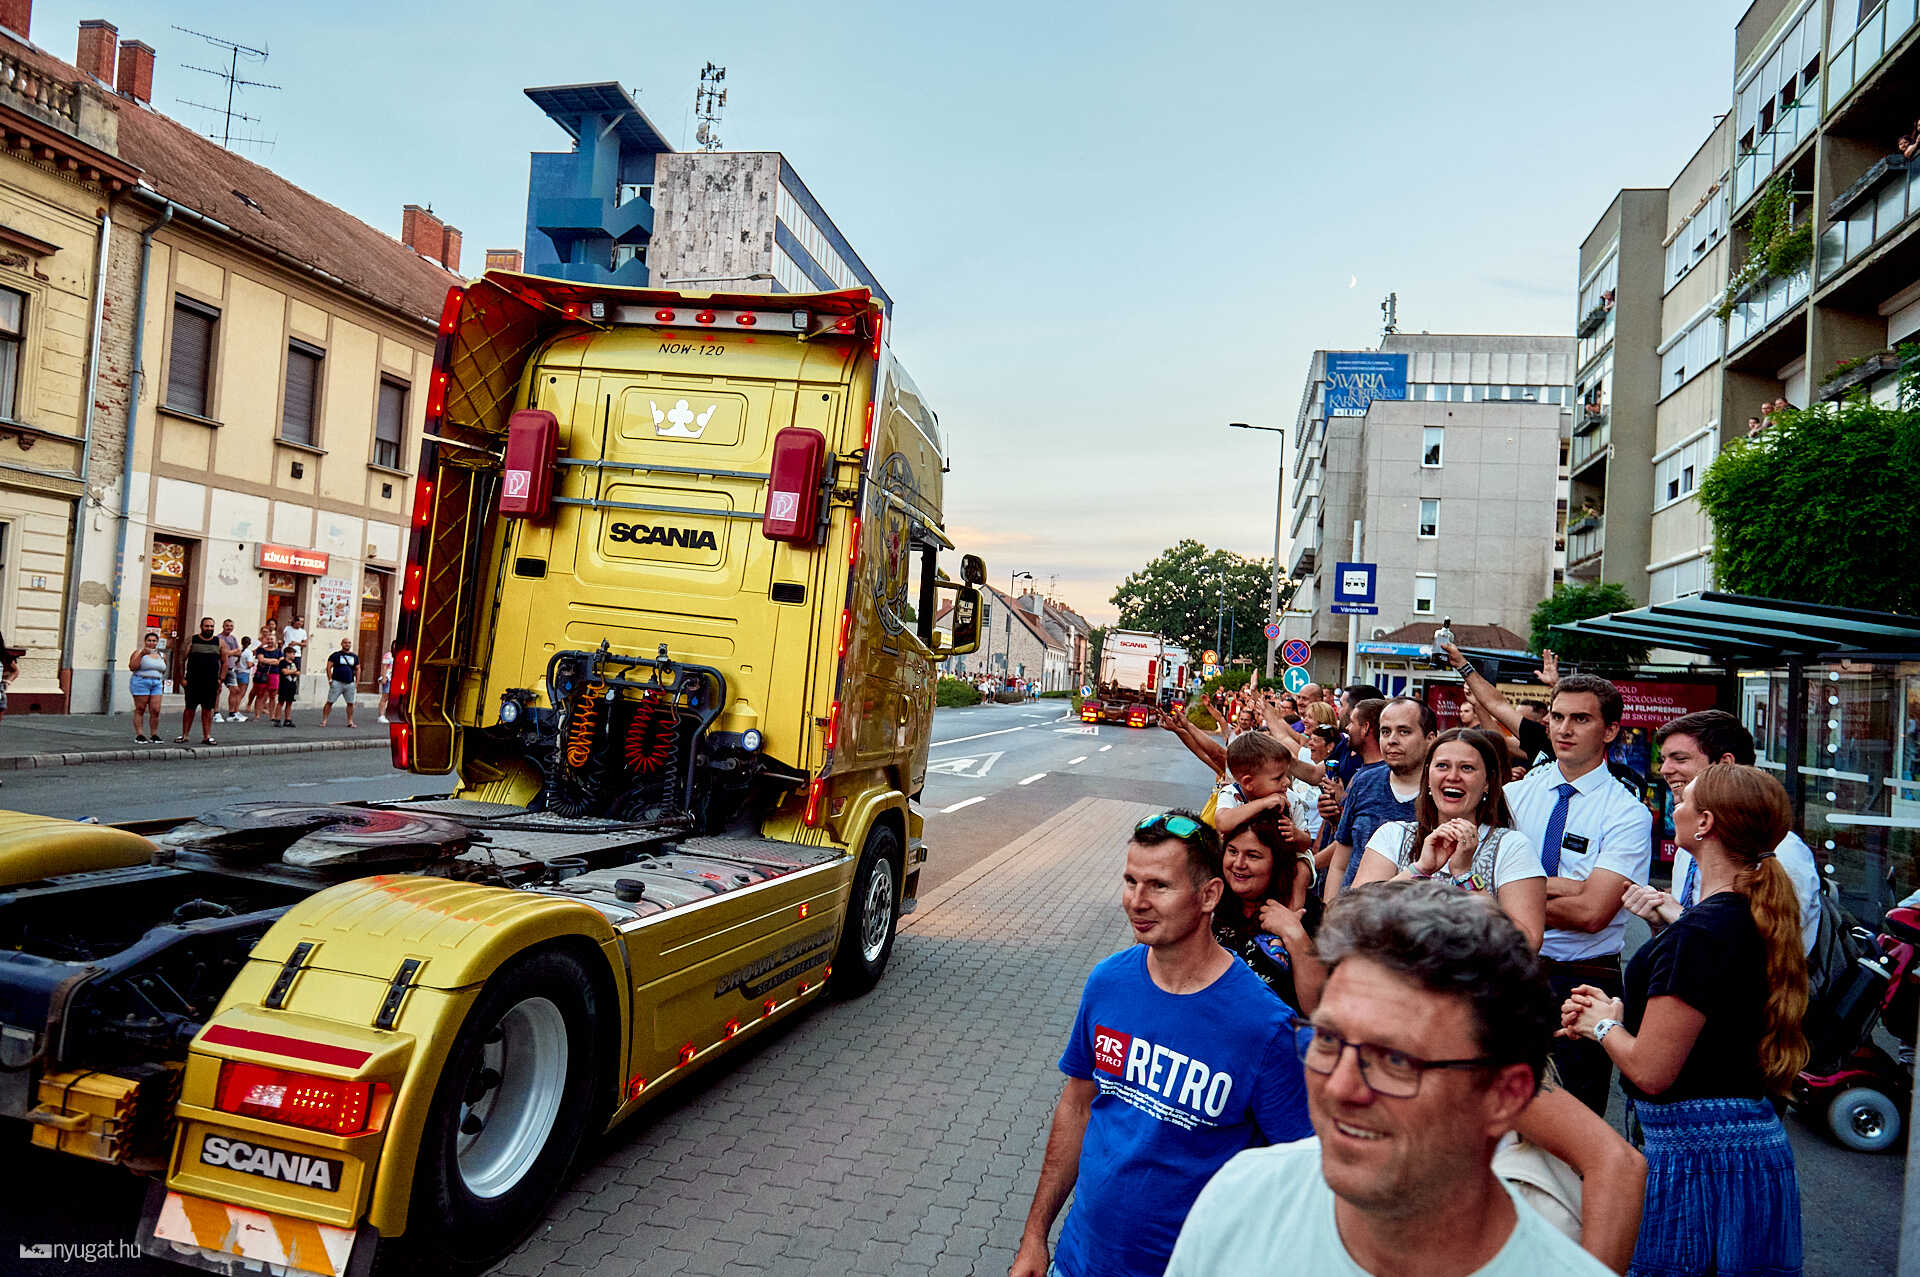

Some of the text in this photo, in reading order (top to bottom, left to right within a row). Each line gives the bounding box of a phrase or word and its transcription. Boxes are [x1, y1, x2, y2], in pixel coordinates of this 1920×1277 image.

[658, 343, 725, 356] NOW-120
[609, 522, 718, 551] SCANIA
[263, 552, 326, 569] KÍNAI ÉTTEREM
[1119, 641, 1148, 649] SCANIA
[1095, 1052, 1122, 1068] ETRO
[1126, 1037, 1233, 1118] RETRO
[202, 1137, 332, 1190] SCANIA
